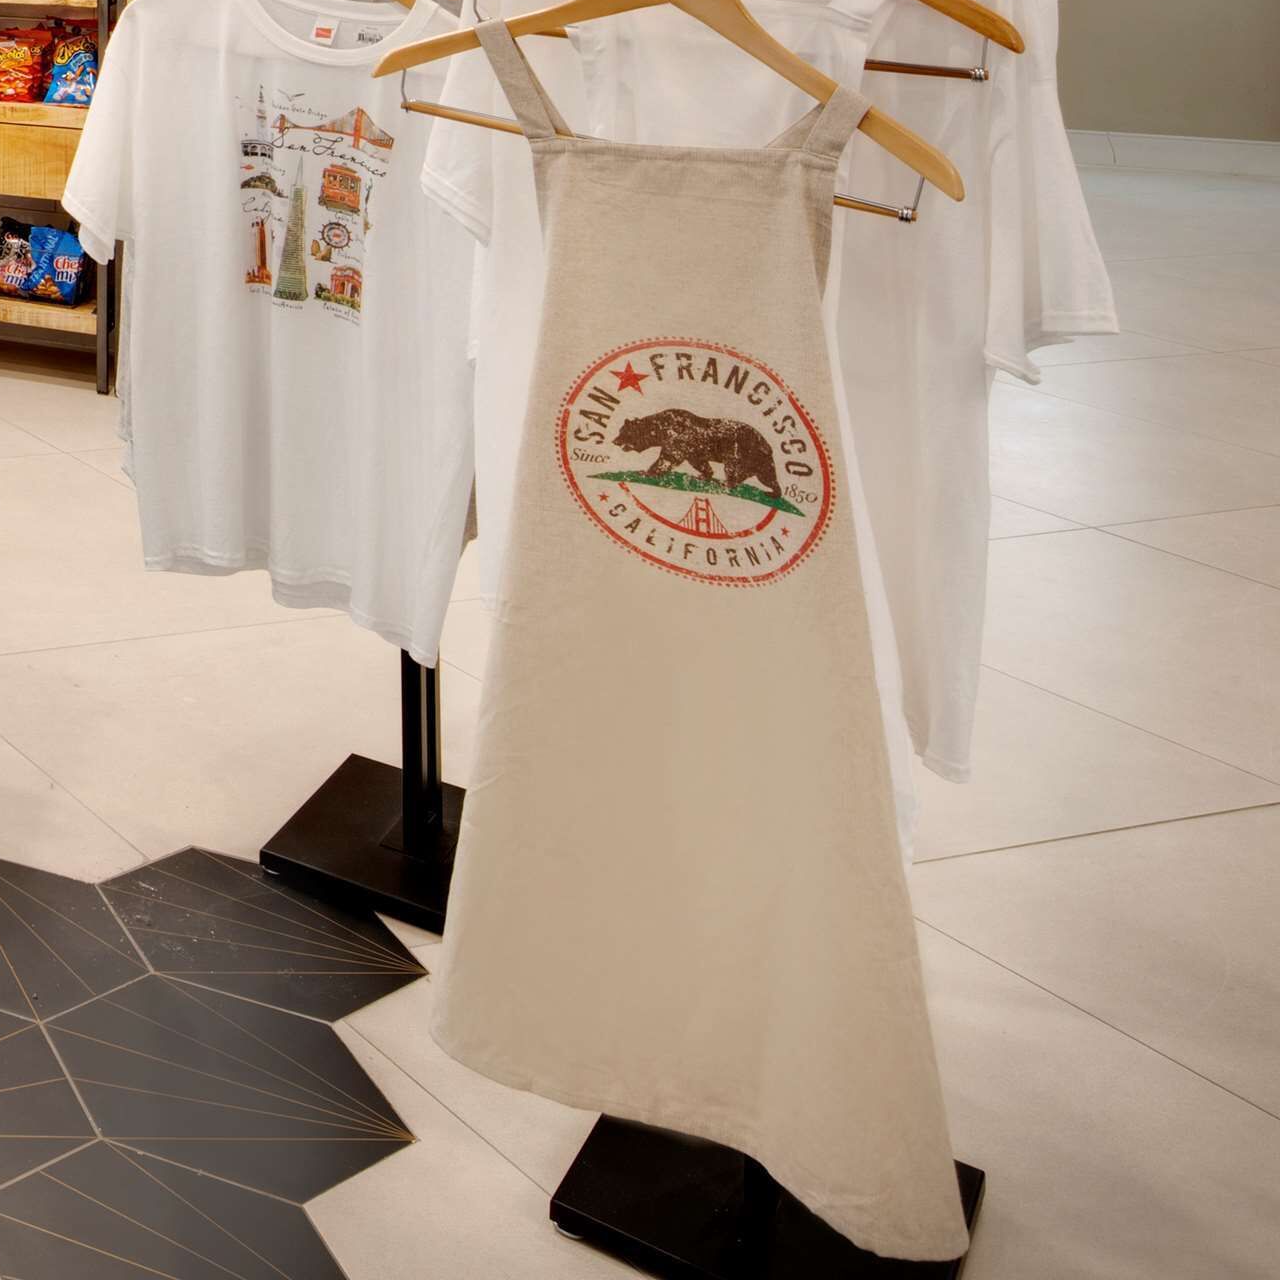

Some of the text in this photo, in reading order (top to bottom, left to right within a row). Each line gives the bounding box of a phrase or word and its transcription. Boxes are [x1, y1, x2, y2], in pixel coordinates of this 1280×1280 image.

[574, 385, 621, 445] SAN
[570, 447, 612, 465] Since
[784, 484, 819, 506] 1850
